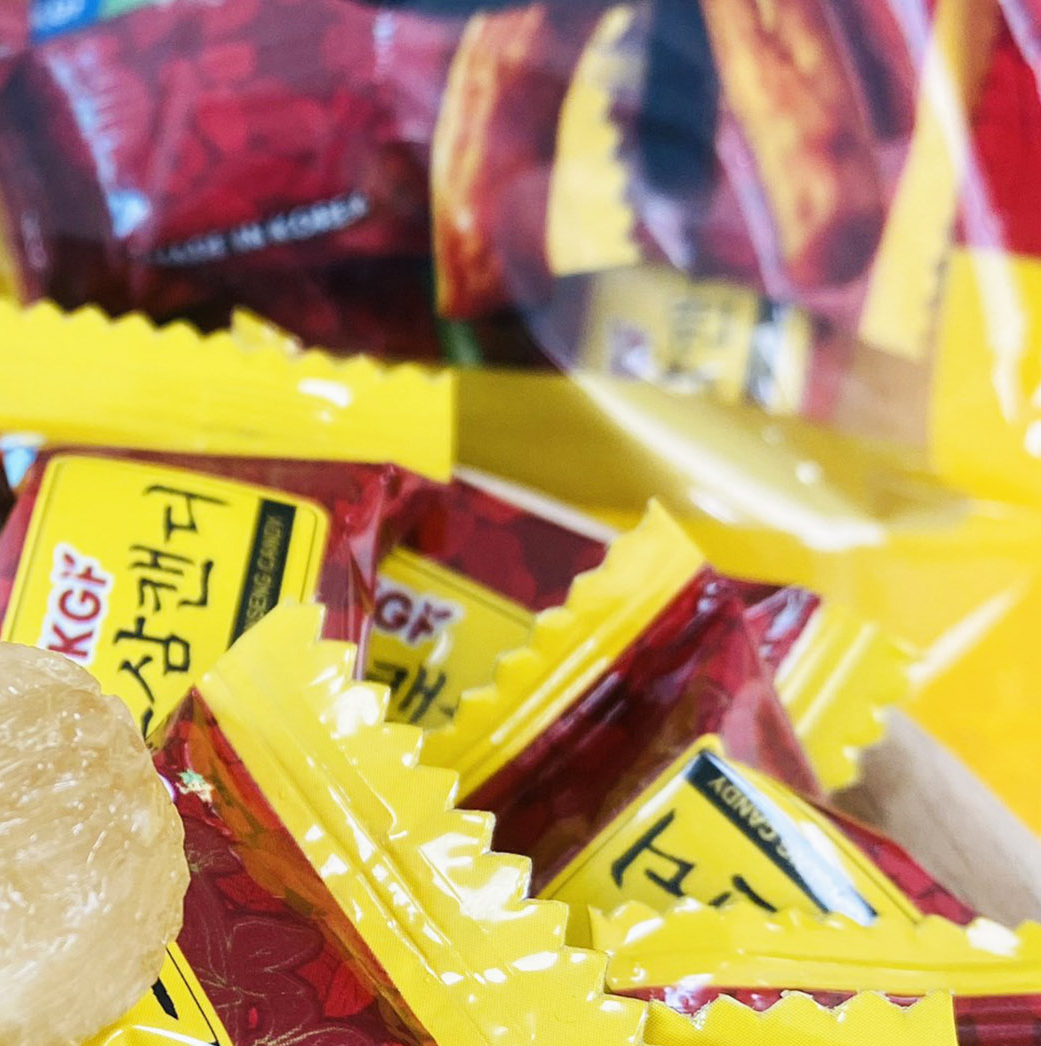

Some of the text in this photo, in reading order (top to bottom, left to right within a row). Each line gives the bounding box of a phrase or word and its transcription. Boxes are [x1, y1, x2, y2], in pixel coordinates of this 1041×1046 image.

[47, 551, 109, 658] KGF
[112, 484, 231, 740] 삼캔디
[374, 590, 452, 643] GF
